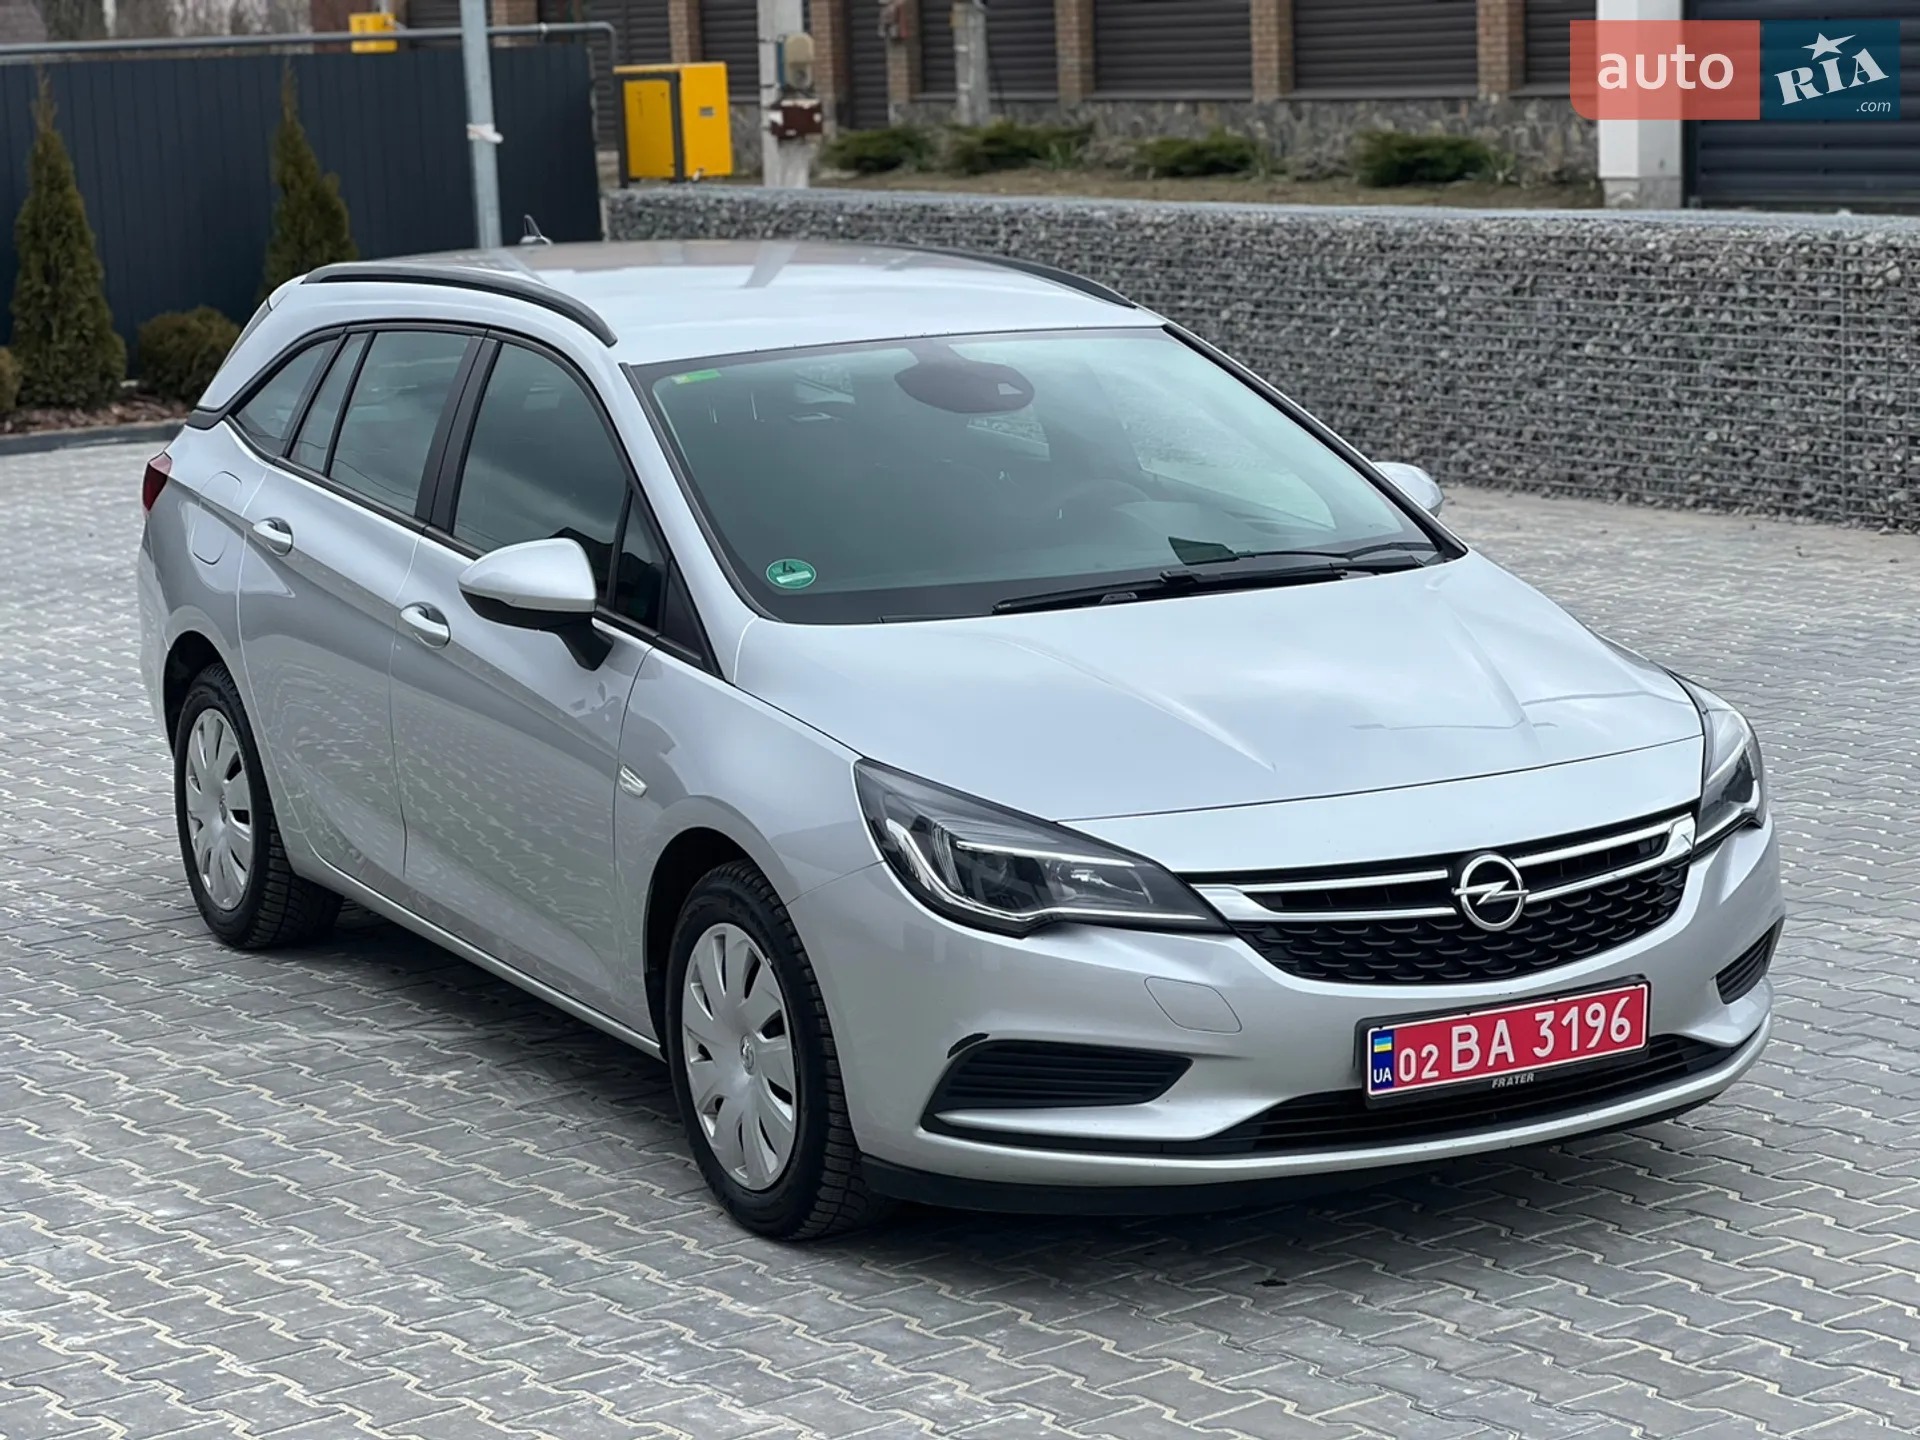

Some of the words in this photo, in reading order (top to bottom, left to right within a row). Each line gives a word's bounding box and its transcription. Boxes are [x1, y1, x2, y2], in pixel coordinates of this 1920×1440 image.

[1399, 1044, 1439, 1082] 02
[1451, 1019, 1515, 1072] BA
[1533, 997, 1631, 1057] 3196
[1373, 1067, 1392, 1083] UA
[1491, 1072, 1535, 1089] FRATER
